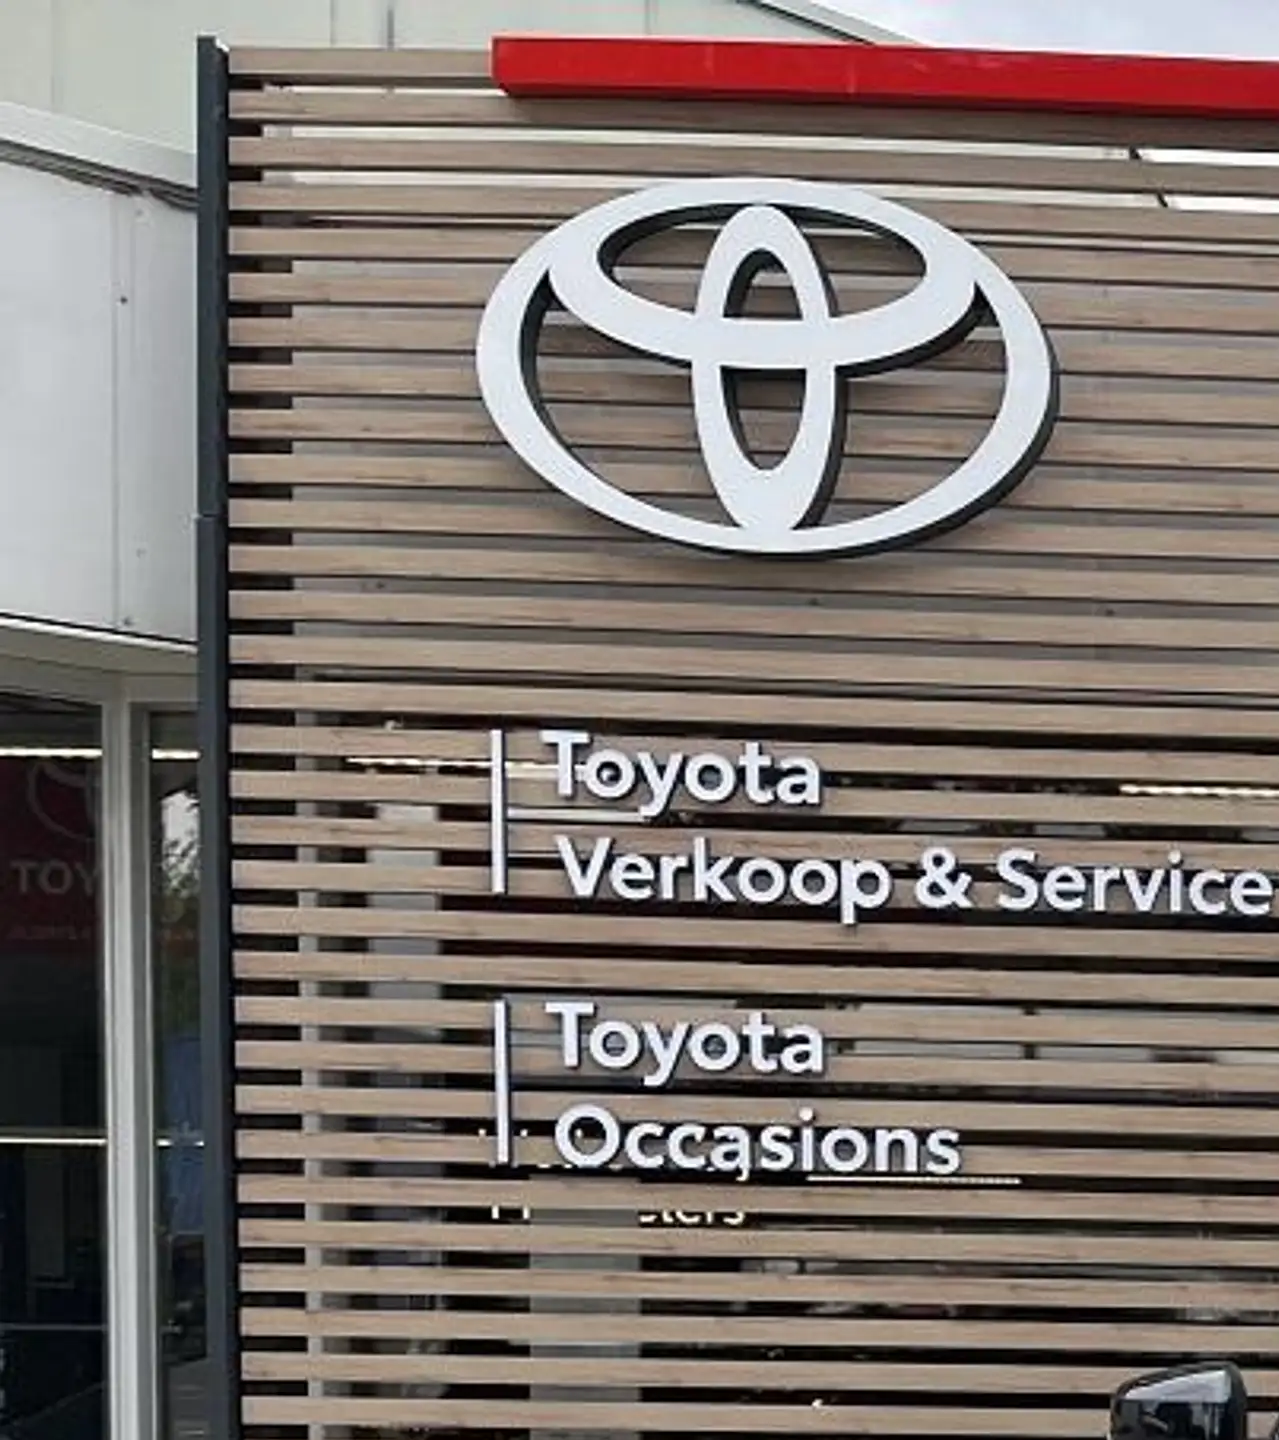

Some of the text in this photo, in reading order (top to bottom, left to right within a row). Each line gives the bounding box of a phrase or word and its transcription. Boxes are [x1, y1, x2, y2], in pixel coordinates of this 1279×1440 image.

[539, 729, 822, 818] Toyota
[554, 834, 1275, 925] Verkoop & Service
[545, 1001, 824, 1086] Toyota
[554, 1104, 961, 1176] Occasions
